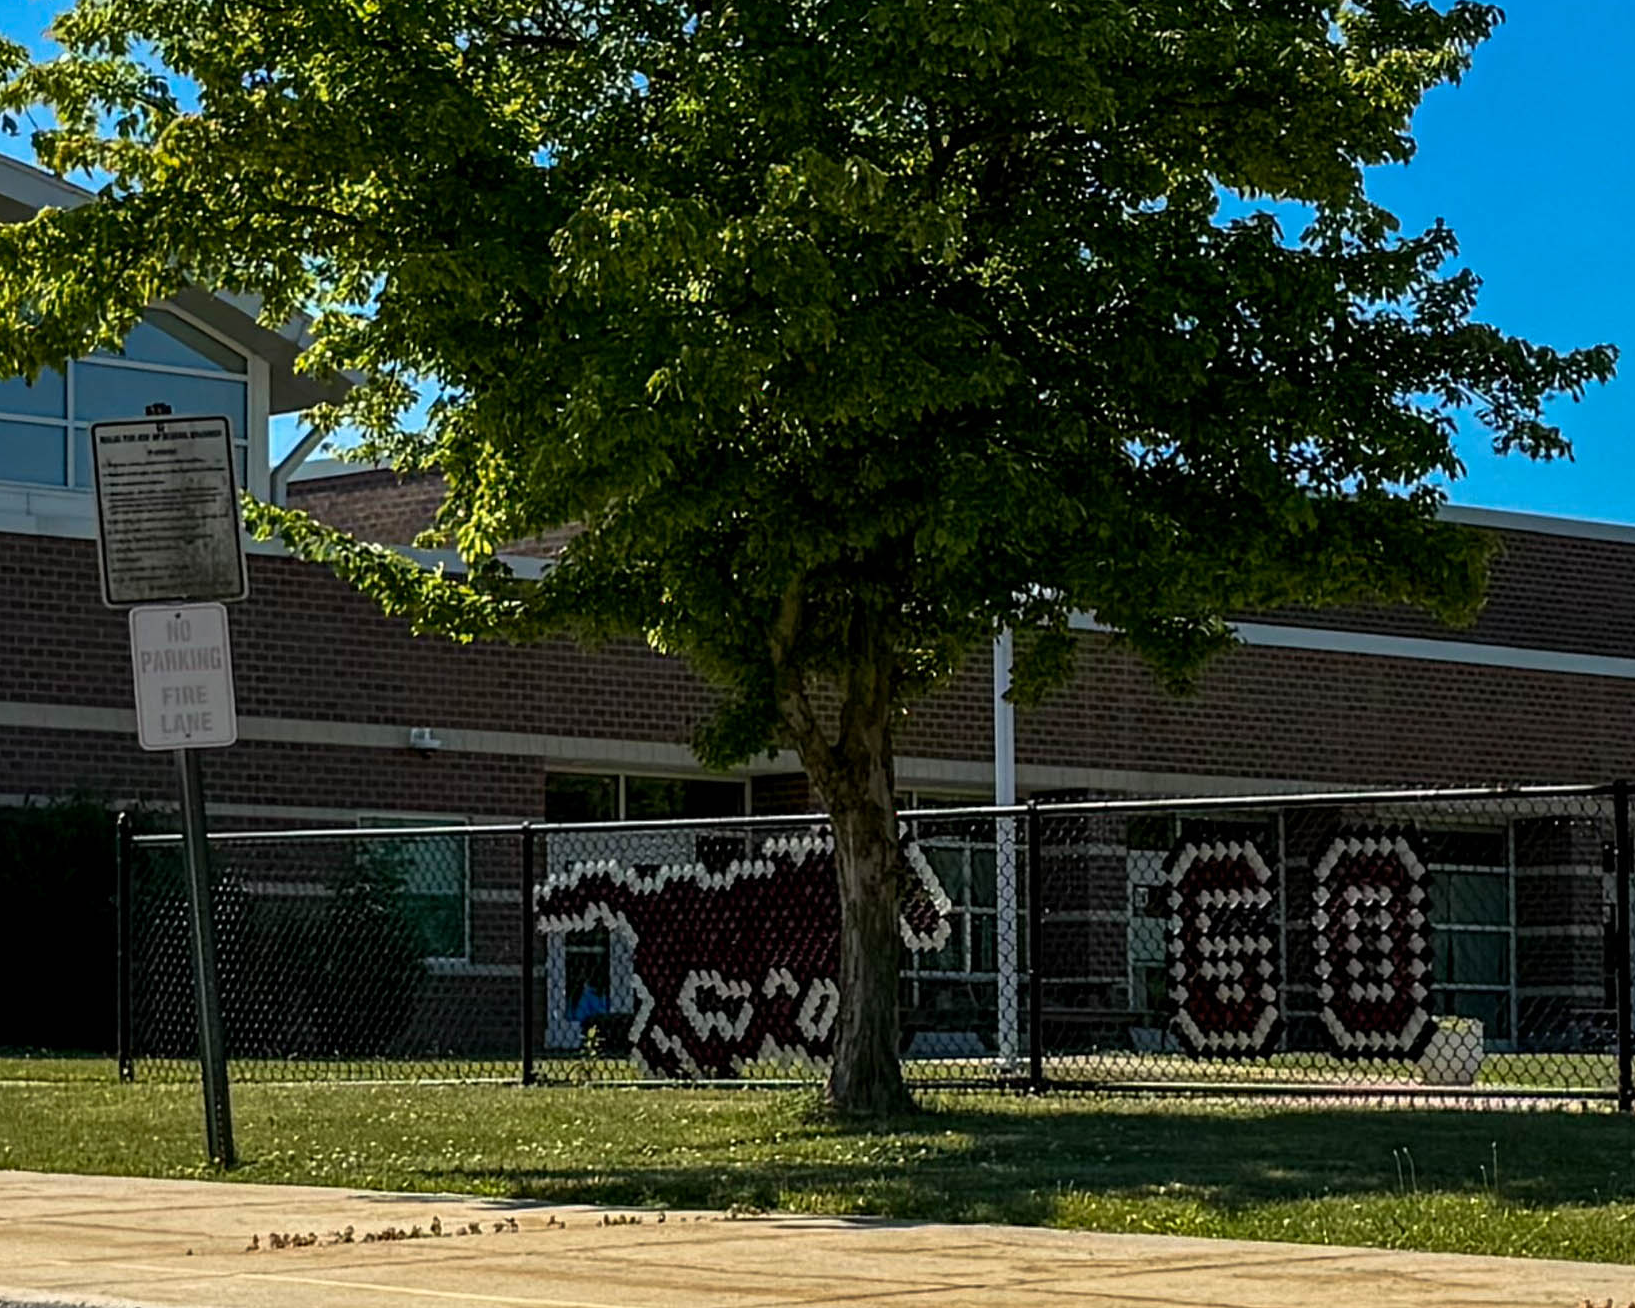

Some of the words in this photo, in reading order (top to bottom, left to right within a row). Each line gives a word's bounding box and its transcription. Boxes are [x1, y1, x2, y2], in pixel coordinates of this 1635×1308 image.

[166, 619, 191, 643] NO
[140, 645, 222, 673] PARKING
[162, 685, 208, 706] FIRE
[161, 711, 213, 734] LANE
[1163, 833, 1430, 1054] GO
